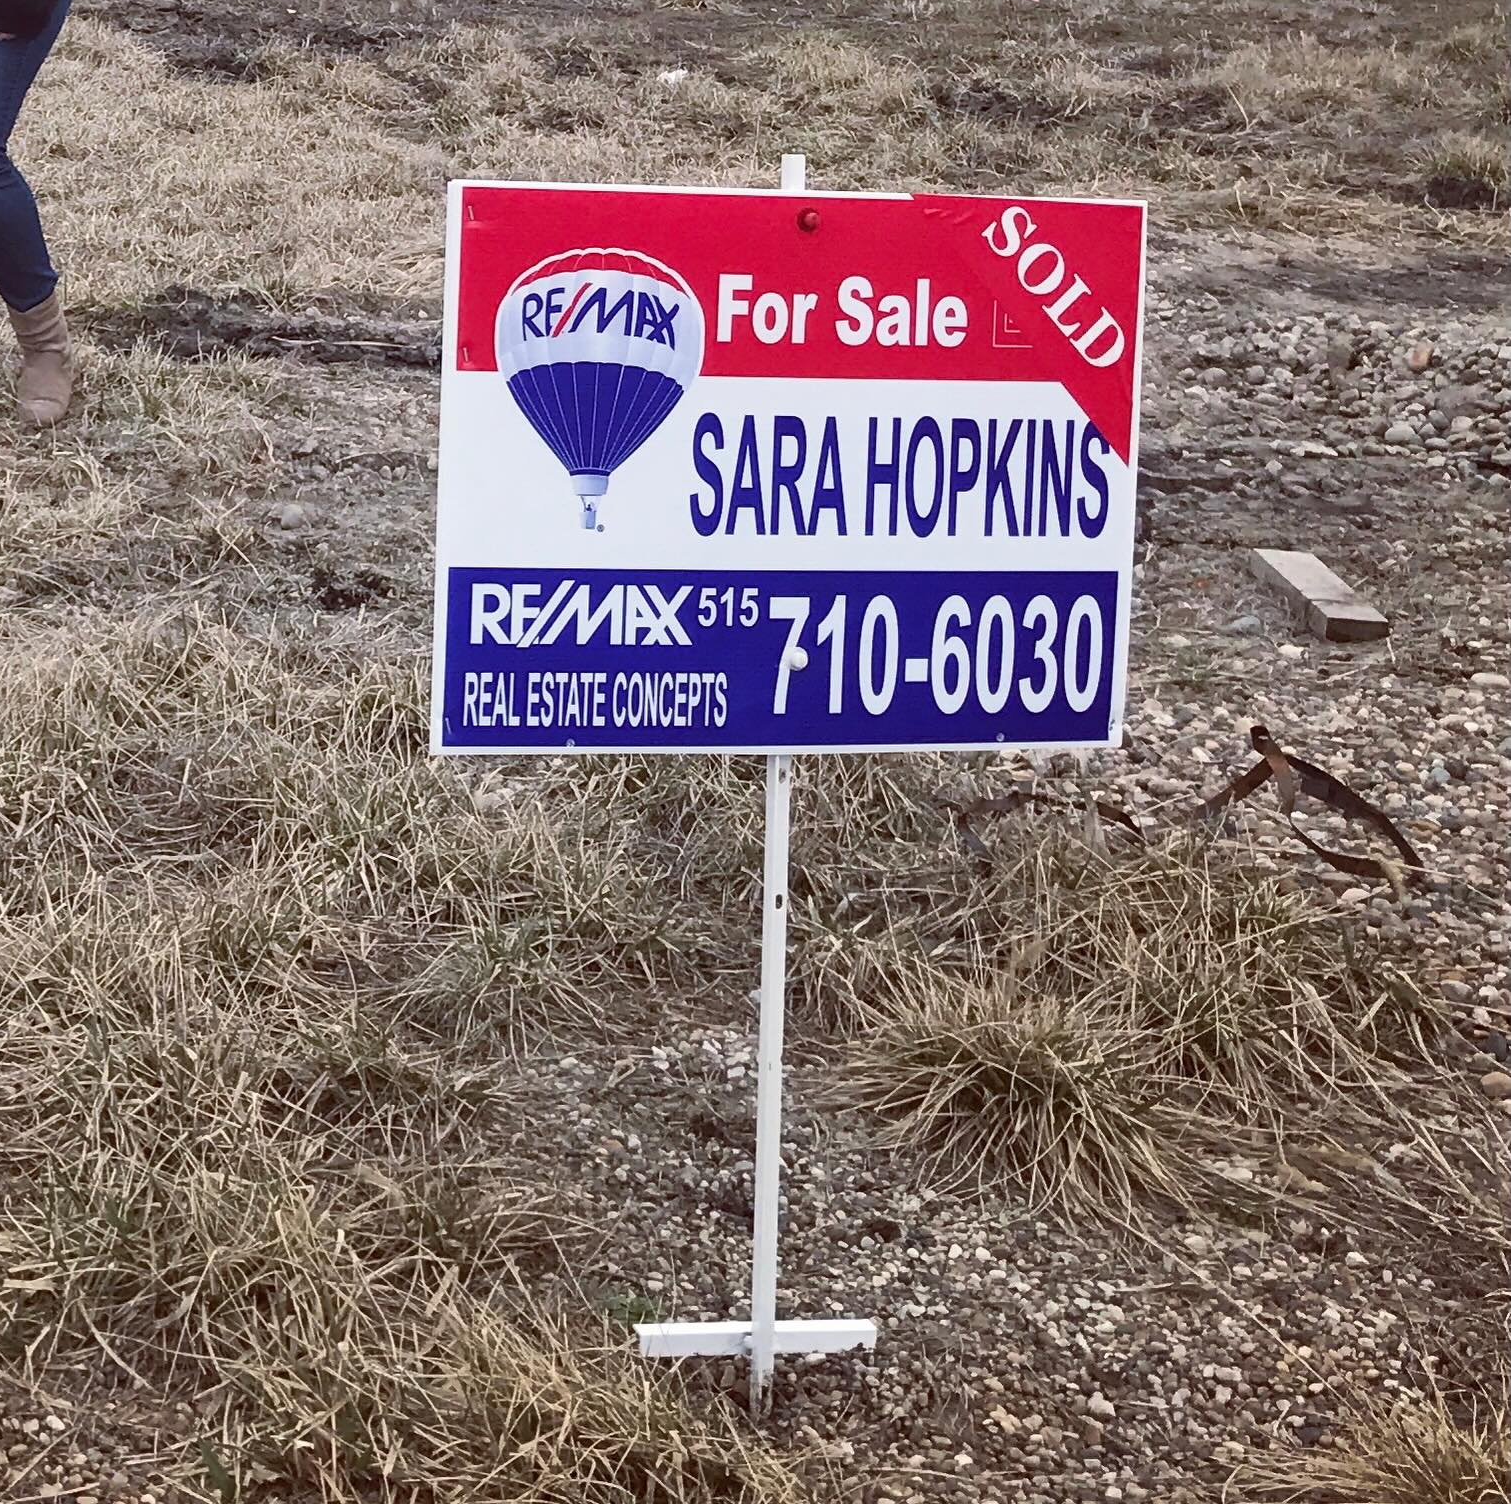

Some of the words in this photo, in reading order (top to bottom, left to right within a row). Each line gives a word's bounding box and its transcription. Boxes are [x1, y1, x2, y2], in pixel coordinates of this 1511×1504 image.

[522, 282, 680, 351] RE/MAX
[716, 274, 819, 345] For
[835, 276, 968, 347] Sale
[981, 206, 1125, 368] SOLD
[689, 412, 847, 536] SARA
[865, 415, 1110, 538] HOPKINS
[469, 580, 694, 648] RE/MAX
[697, 587, 759, 627] 515
[769, 594, 1103, 715] 710-6030
[462, 672, 520, 727] REAL
[526, 672, 606, 727] ESTATE
[612, 672, 728, 727] CONCEPTS
